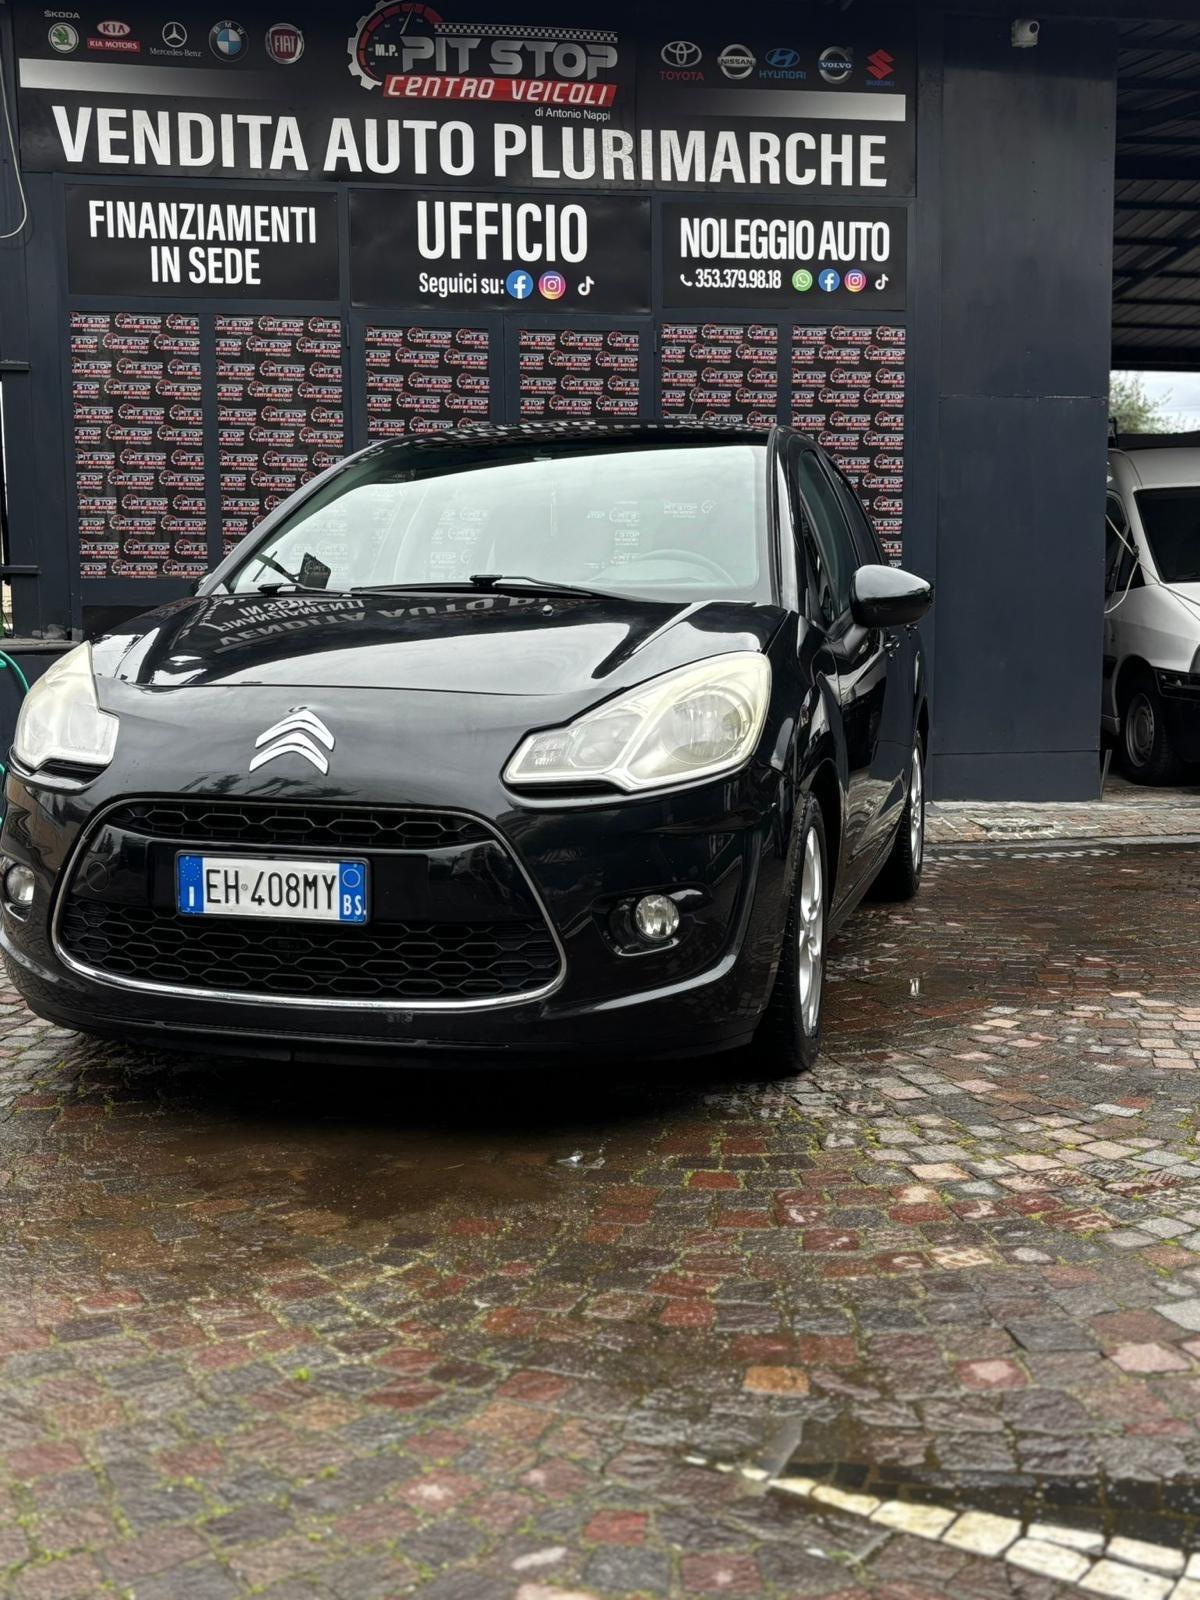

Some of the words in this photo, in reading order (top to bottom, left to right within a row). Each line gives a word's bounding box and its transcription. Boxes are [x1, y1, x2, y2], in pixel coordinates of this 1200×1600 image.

[44, 10, 80, 19] ŠKODA
[102, 24, 126, 34] KIA
[90, 40, 103, 48] KIA
[105, 41, 138, 50] MOTORS
[150, 47, 203, 57] Mercedes-Benz
[274, 35, 296, 52] FIAT
[375, 44, 398, 56] M.P.
[400, 36, 482, 74] PIT
[489, 40, 618, 80] STOP
[720, 58, 752, 66] NISSAN
[661, 71, 704, 81] TOYOTA
[759, 70, 806, 80] HYUNDAI
[535, 107, 543, 117] di
[546, 108, 582, 119] Antonio
[583, 109, 611, 121] Nappi
[52, 106, 308, 171] VENDITA
[323, 117, 475, 176] AUTO
[494, 123, 887, 187] PLURIMARCHE
[89, 200, 317, 243] FINANZIAMENTI
[417, 200, 588, 263] UFFICIO
[680, 217, 815, 260] NOLEGGIO
[818, 221, 890, 262] AUTO
[151, 246, 180, 282] IN
[188, 246, 261, 285] SEDE
[419, 272, 477, 298] Seguici
[481, 276, 504, 294] su:
[695, 268, 782, 289] 353.379.98.18
[206, 869, 240, 905] EH
[250, 871, 336, 910] 408MY
